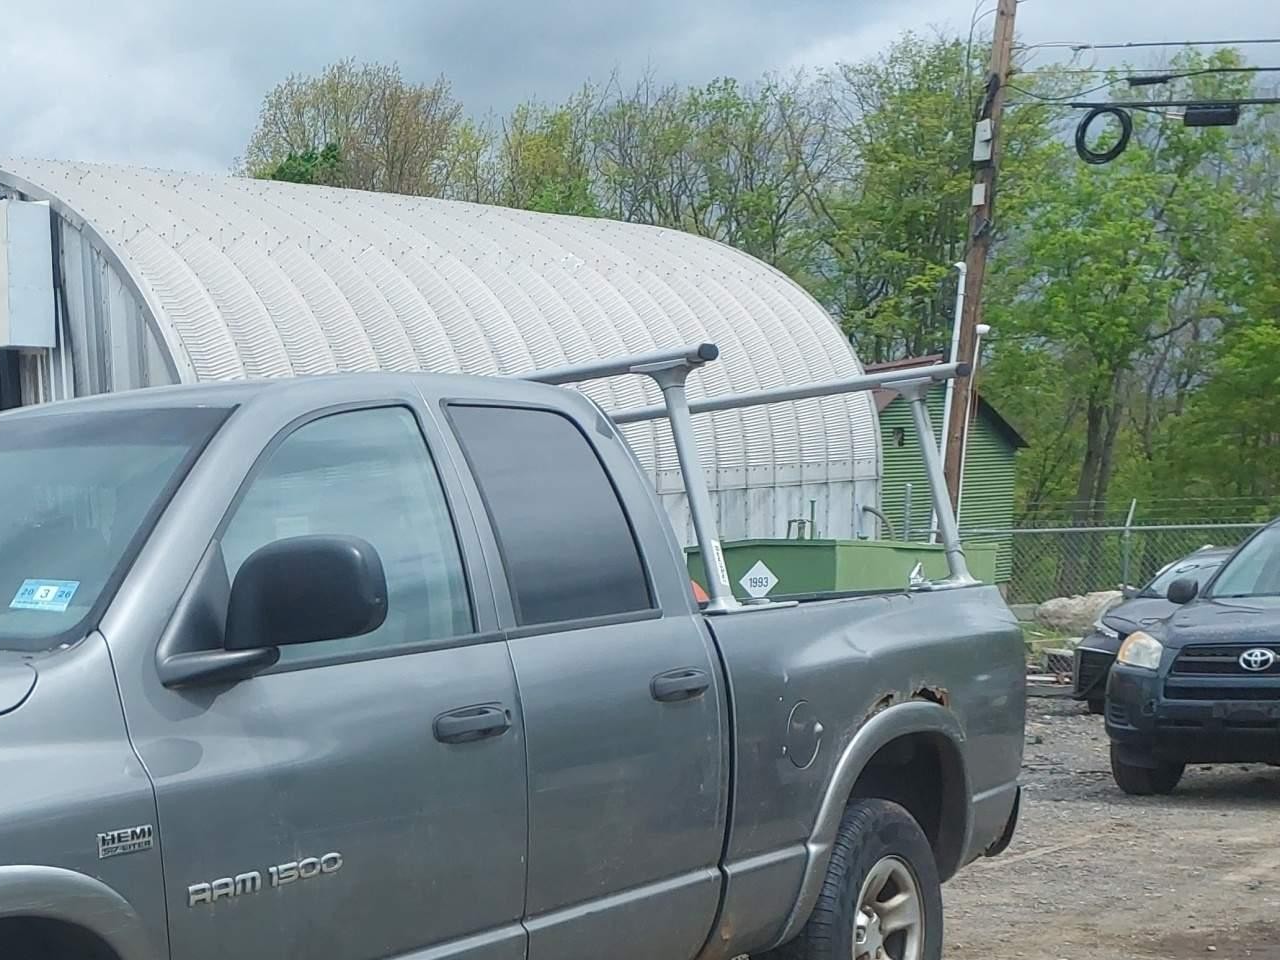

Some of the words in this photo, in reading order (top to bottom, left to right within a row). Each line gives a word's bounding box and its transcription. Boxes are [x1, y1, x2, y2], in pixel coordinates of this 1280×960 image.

[748, 577, 769, 588] 1993
[40, 589, 50, 598] 3
[101, 826, 151, 847] HEMI
[188, 871, 262, 906] RAM
[269, 852, 343, 887] 1500
